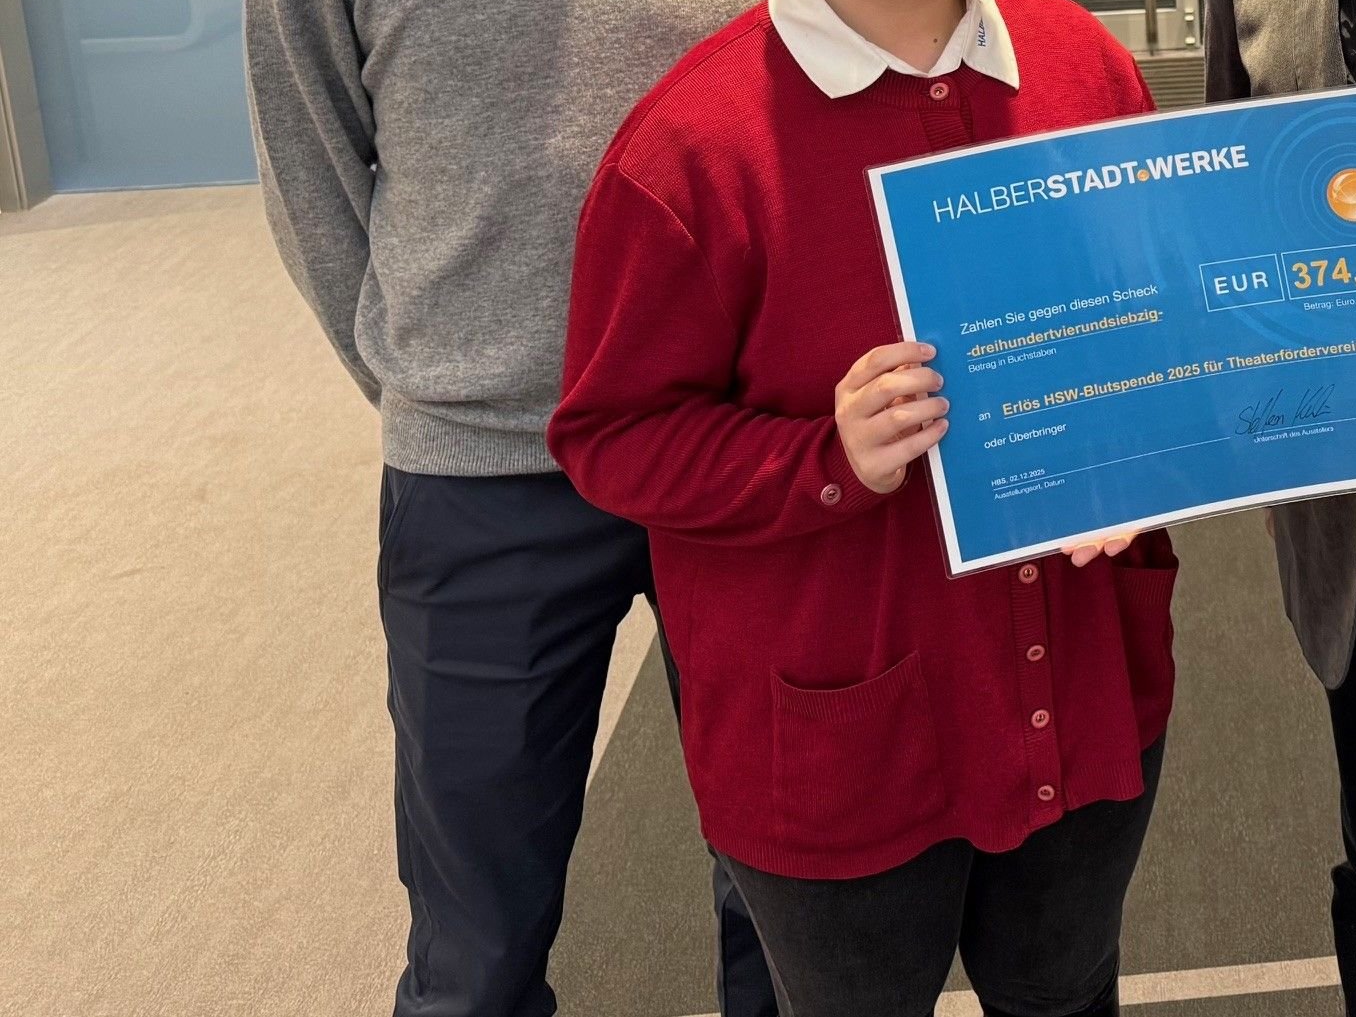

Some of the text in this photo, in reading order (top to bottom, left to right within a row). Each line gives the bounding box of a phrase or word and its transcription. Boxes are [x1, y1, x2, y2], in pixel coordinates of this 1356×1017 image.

[1214, 271, 1269, 295] EUR
[960, 284, 1159, 335] Zahlen Sie gegen diesen Scheck
[1304, 299, 1334, 310] Betrag:
[966, 307, 1164, 358] -dreihundertvierundsiebzig-
[968, 347, 1057, 373] Betrag in Buchstaben
[978, 410, 991, 421] an
[1002, 398, 1040, 416] Erlös
[1044, 372, 1164, 406] HSW-Blutspende
[1167, 362, 1201, 381] 2025
[1203, 360, 1224, 373] für
[984, 424, 1067, 449] oder Überbringer
[1044, 478, 1065, 489] Datum
